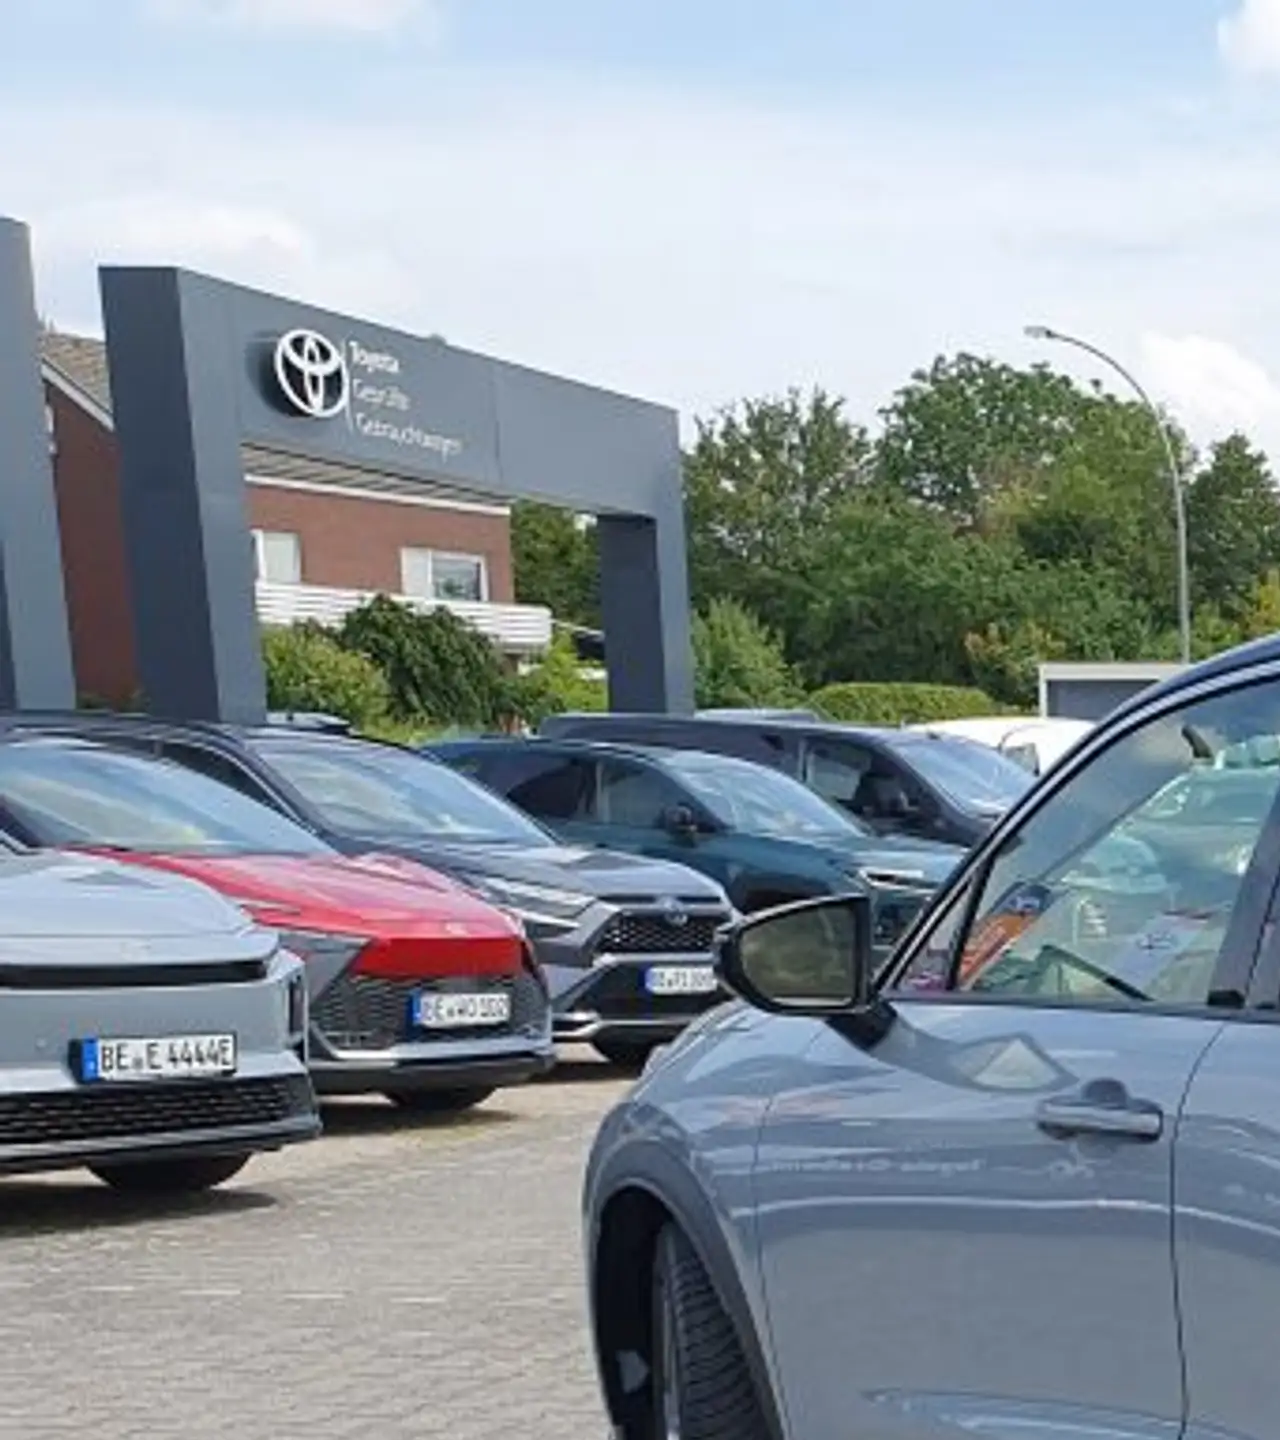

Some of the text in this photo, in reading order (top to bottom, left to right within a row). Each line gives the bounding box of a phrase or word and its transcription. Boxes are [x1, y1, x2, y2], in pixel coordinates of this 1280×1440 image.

[348, 340, 399, 374] Toyota
[101, 1044, 130, 1073] BE
[147, 1042, 163, 1070] E
